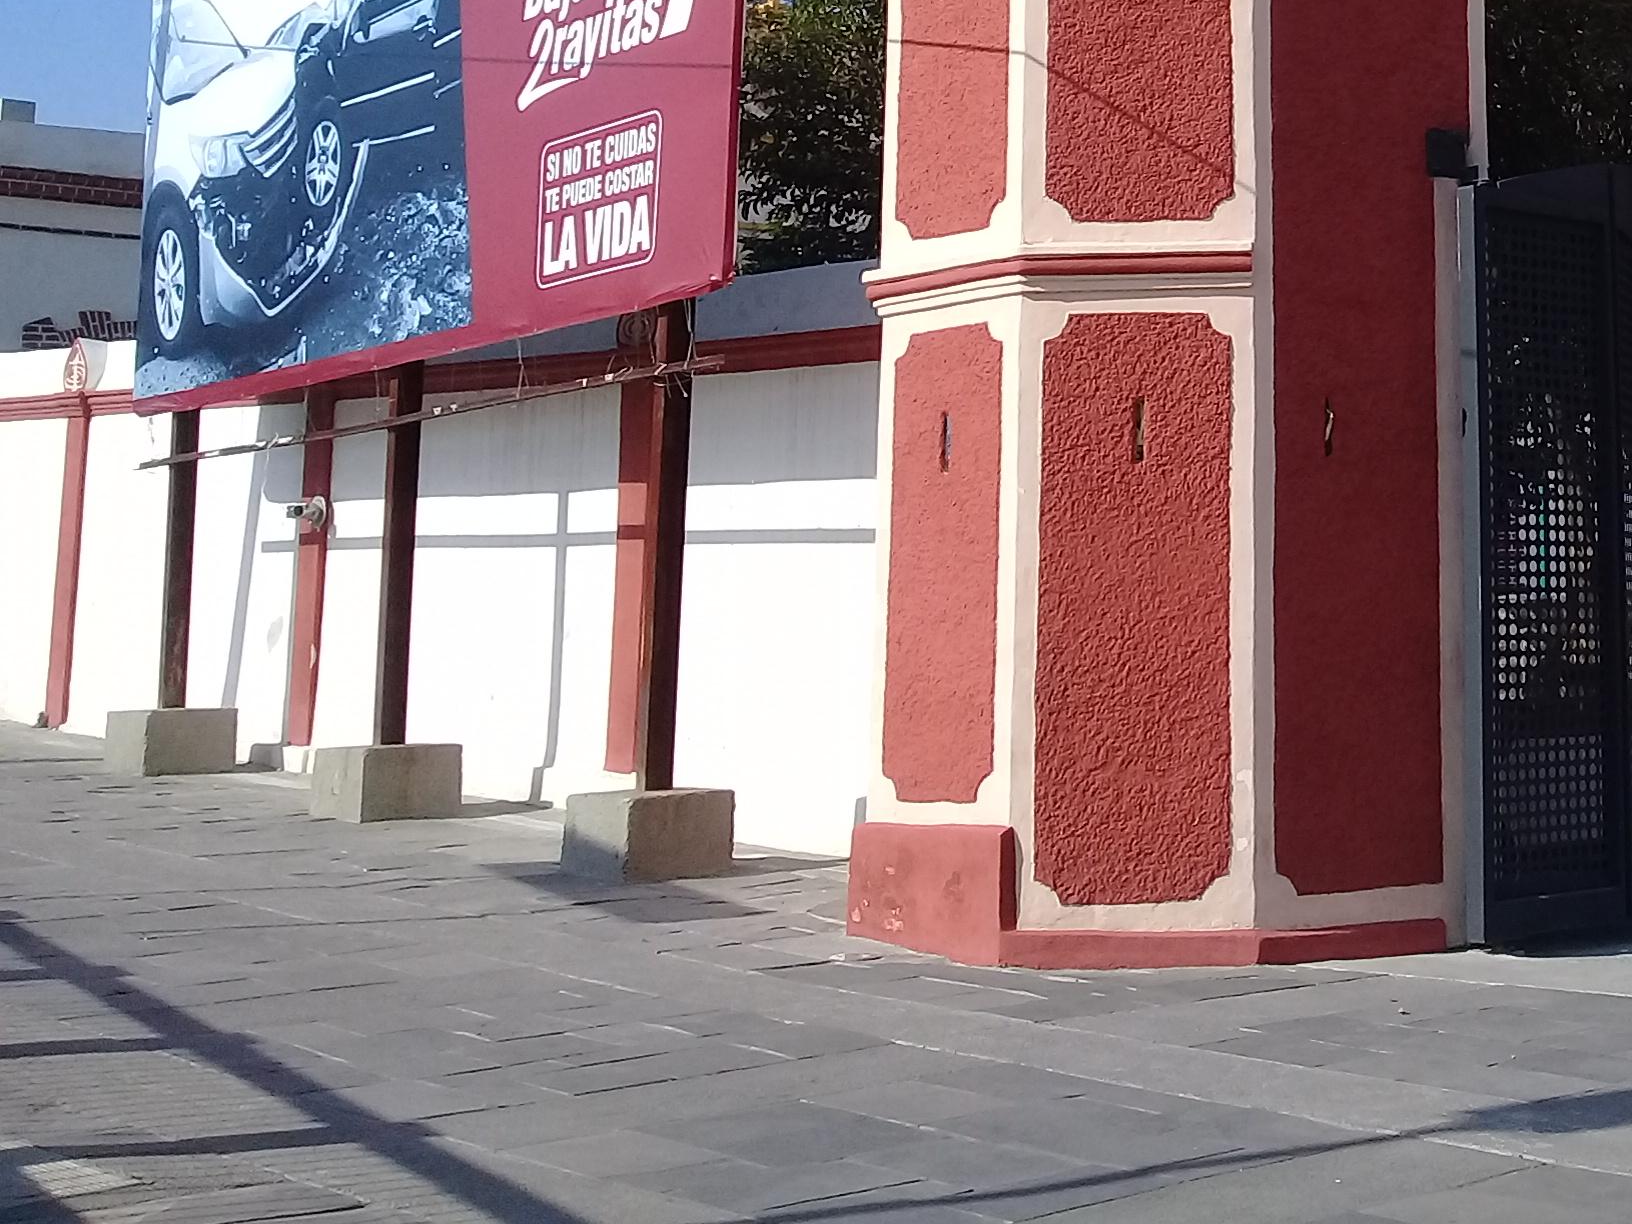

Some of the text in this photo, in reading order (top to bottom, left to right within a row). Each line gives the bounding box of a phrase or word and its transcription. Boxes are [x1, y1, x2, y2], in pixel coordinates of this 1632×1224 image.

[546, 122, 657, 183] SI NO TE CUIDAS
[544, 159, 654, 214] TE PUEDE COSTAR
[542, 194, 651, 277] LA VIDA
